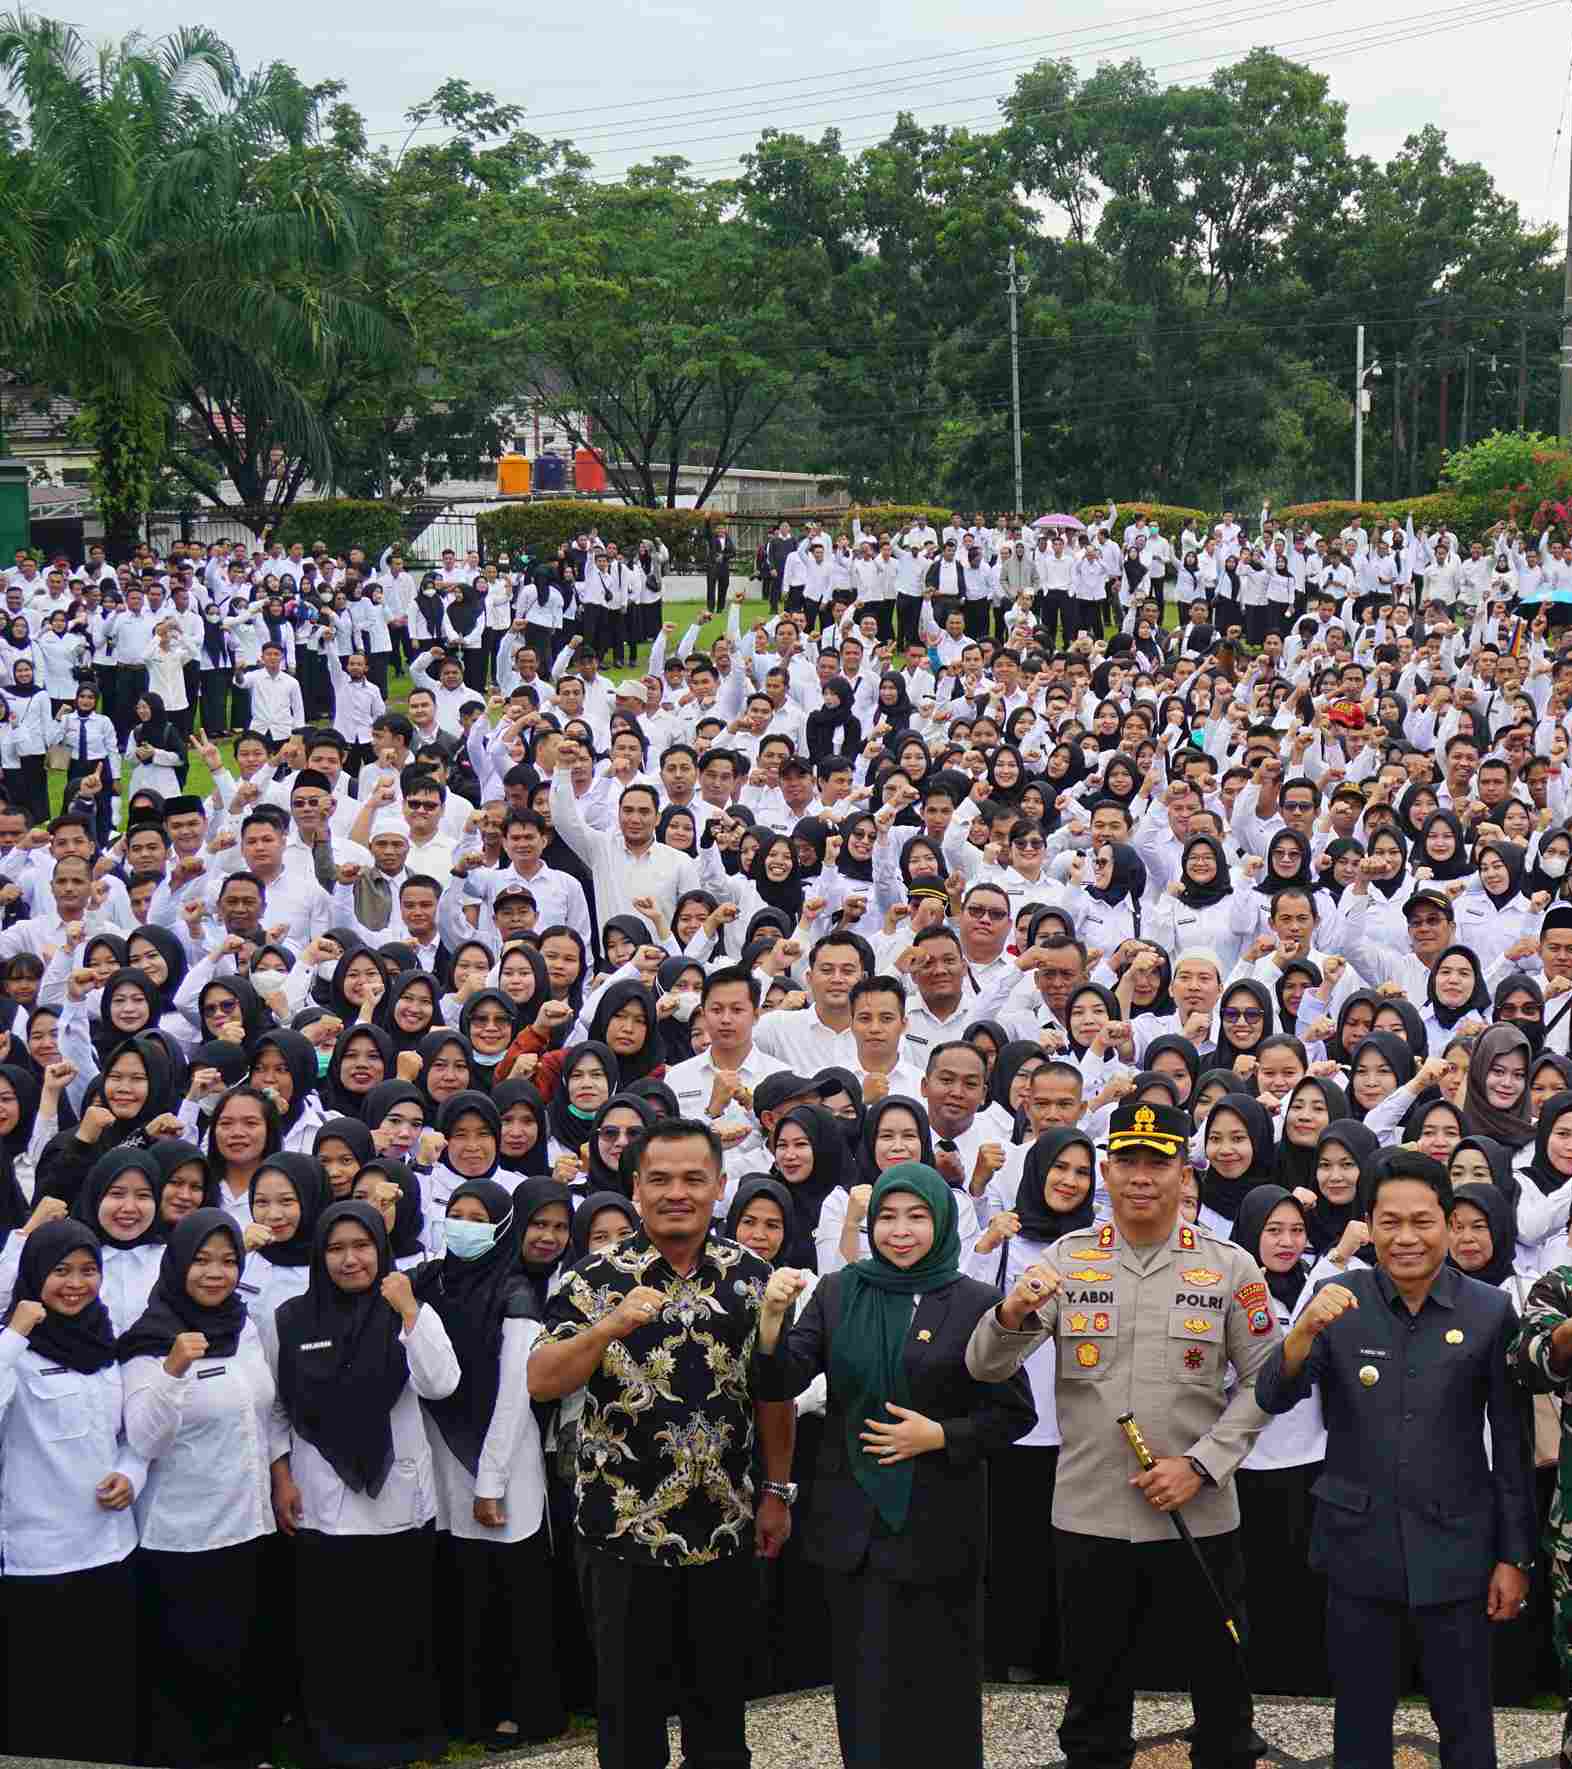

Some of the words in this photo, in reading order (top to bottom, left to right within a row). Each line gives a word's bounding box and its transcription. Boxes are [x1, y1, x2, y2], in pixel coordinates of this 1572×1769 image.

[1065, 1291, 1077, 1304] Y.
[1080, 1291, 1114, 1304] ABDI
[1175, 1293, 1224, 1310] POLRI
